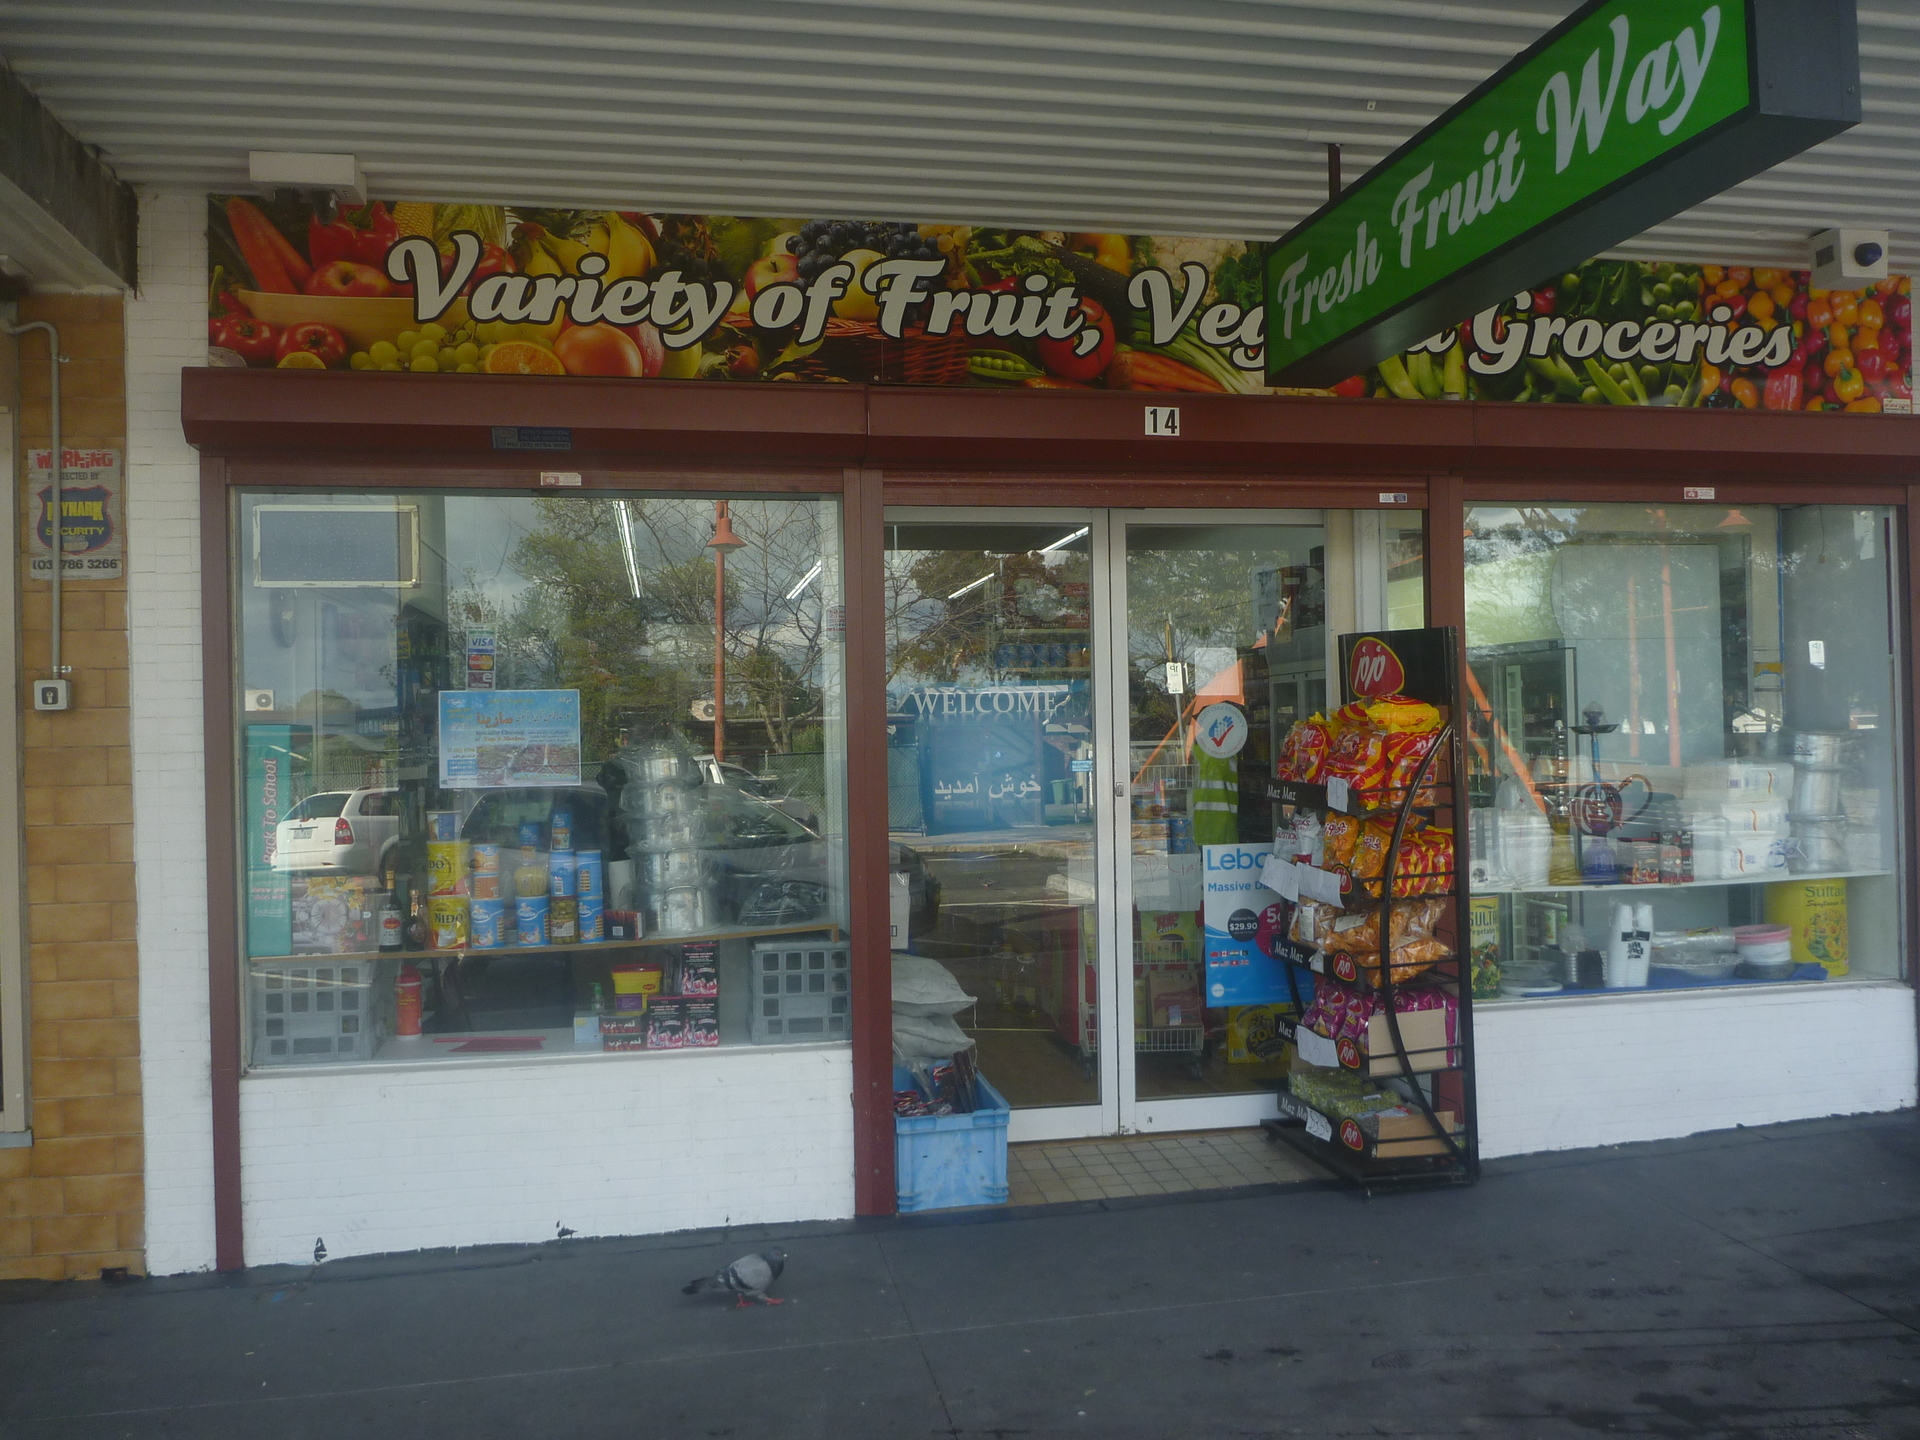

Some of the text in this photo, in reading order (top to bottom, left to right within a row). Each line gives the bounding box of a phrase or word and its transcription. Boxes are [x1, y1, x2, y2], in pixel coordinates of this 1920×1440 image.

[1278, 5, 1721, 339] Fresh Fruit Way
[385, 229, 734, 351] Variety
[750, 258, 854, 345] of
[861, 255, 1101, 358] Fruit,
[1467, 290, 1792, 376] Groceries
[1150, 408, 1178, 434] 14
[36, 450, 113, 469] WRNING
[48, 472, 100, 480] PTECTED BY
[45, 526, 105, 536] SCURITY
[87, 559, 118, 569] 3266
[472, 638, 493, 646] VISA
[911, 691, 1058, 714] WELCOME
[263, 758, 278, 806] School
[934, 772, 1042, 800] خوش آمدید
[1267, 784, 1296, 801] Maz Maz
[263, 808, 278, 828] To
[429, 860, 445, 869] DO
[1207, 847, 1273, 871] Leb
[1208, 880, 1271, 892] Massive Da
[434, 912, 463, 924] NIDO
[1229, 922, 1258, 931] $29.90
[1470, 910, 1497, 926] SULTA
[1274, 941, 1304, 964] Maz Maz
[1278, 1020, 1292, 1038] Maz
[1280, 1096, 1308, 1121] Maz Ma
